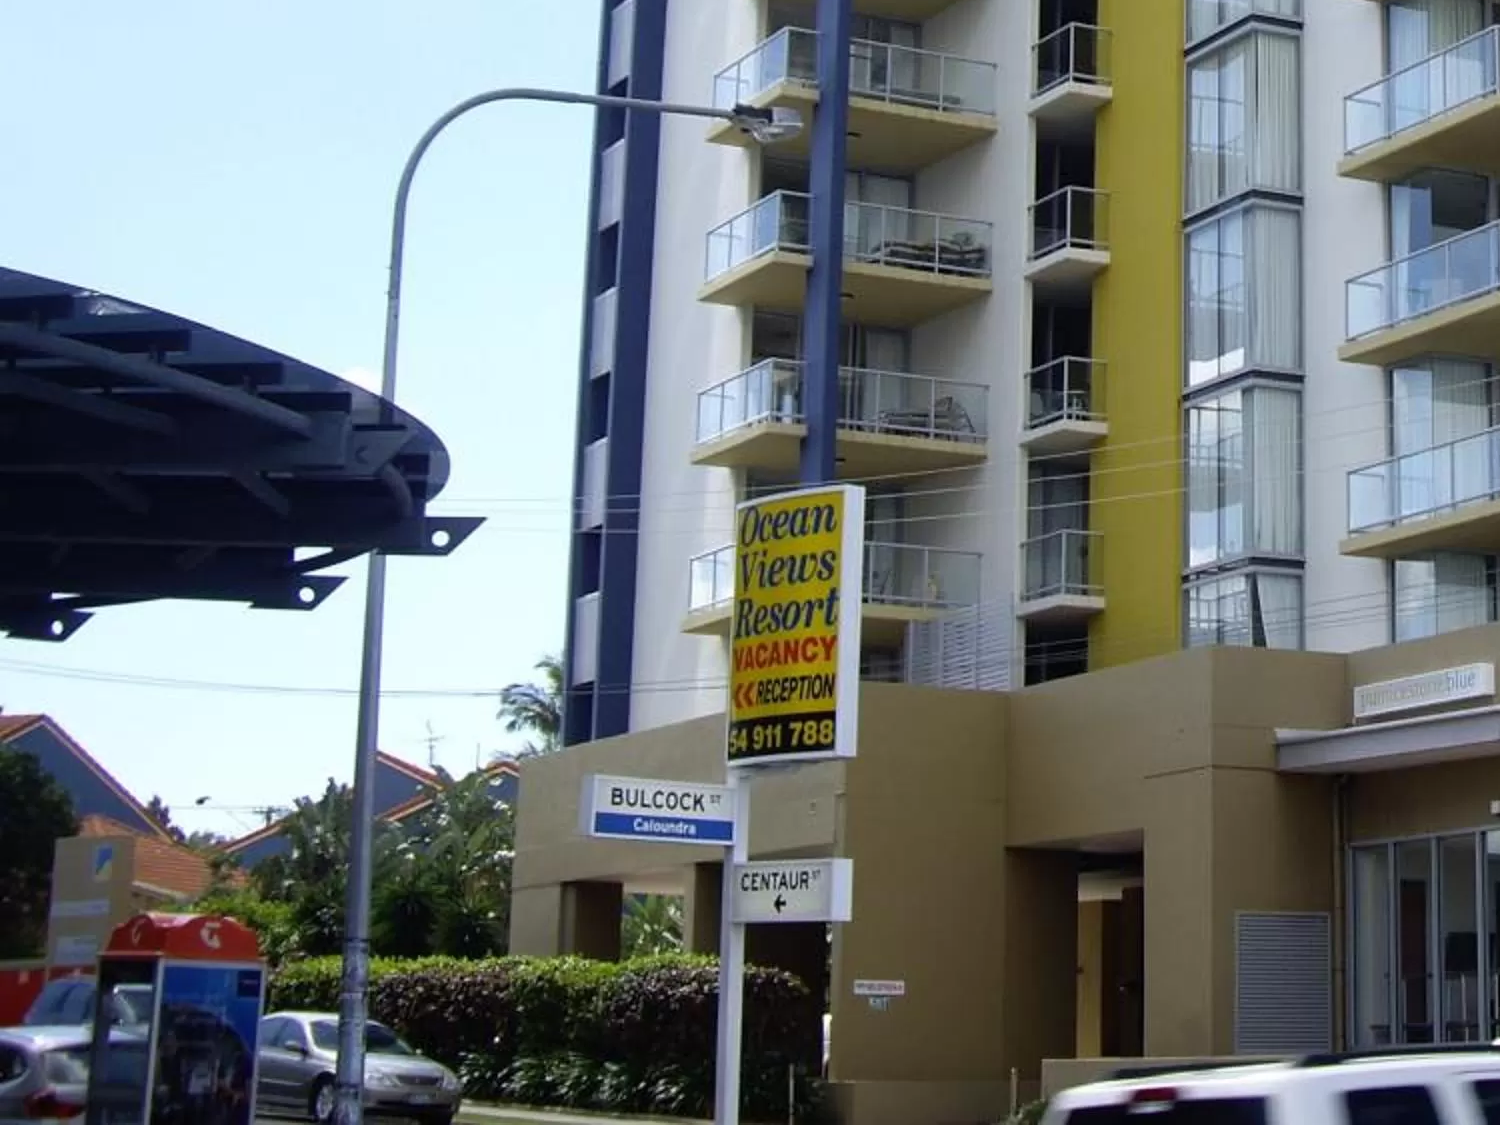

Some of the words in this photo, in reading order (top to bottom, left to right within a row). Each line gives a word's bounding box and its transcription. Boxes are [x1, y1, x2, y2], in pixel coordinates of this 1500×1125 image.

[741, 503, 838, 547] Ocean
[741, 550, 837, 593] Views
[735, 587, 839, 639] Resort
[734, 635, 838, 672] VACANCY
[756, 673, 835, 704] RECEPTION
[729, 728, 749, 753] 54
[752, 723, 783, 750] 911
[788, 718, 834, 747] 788
[611, 787, 706, 813] BULCOCK
[633, 817, 698, 836] Caloundra
[740, 871, 810, 892] CENTAUR
